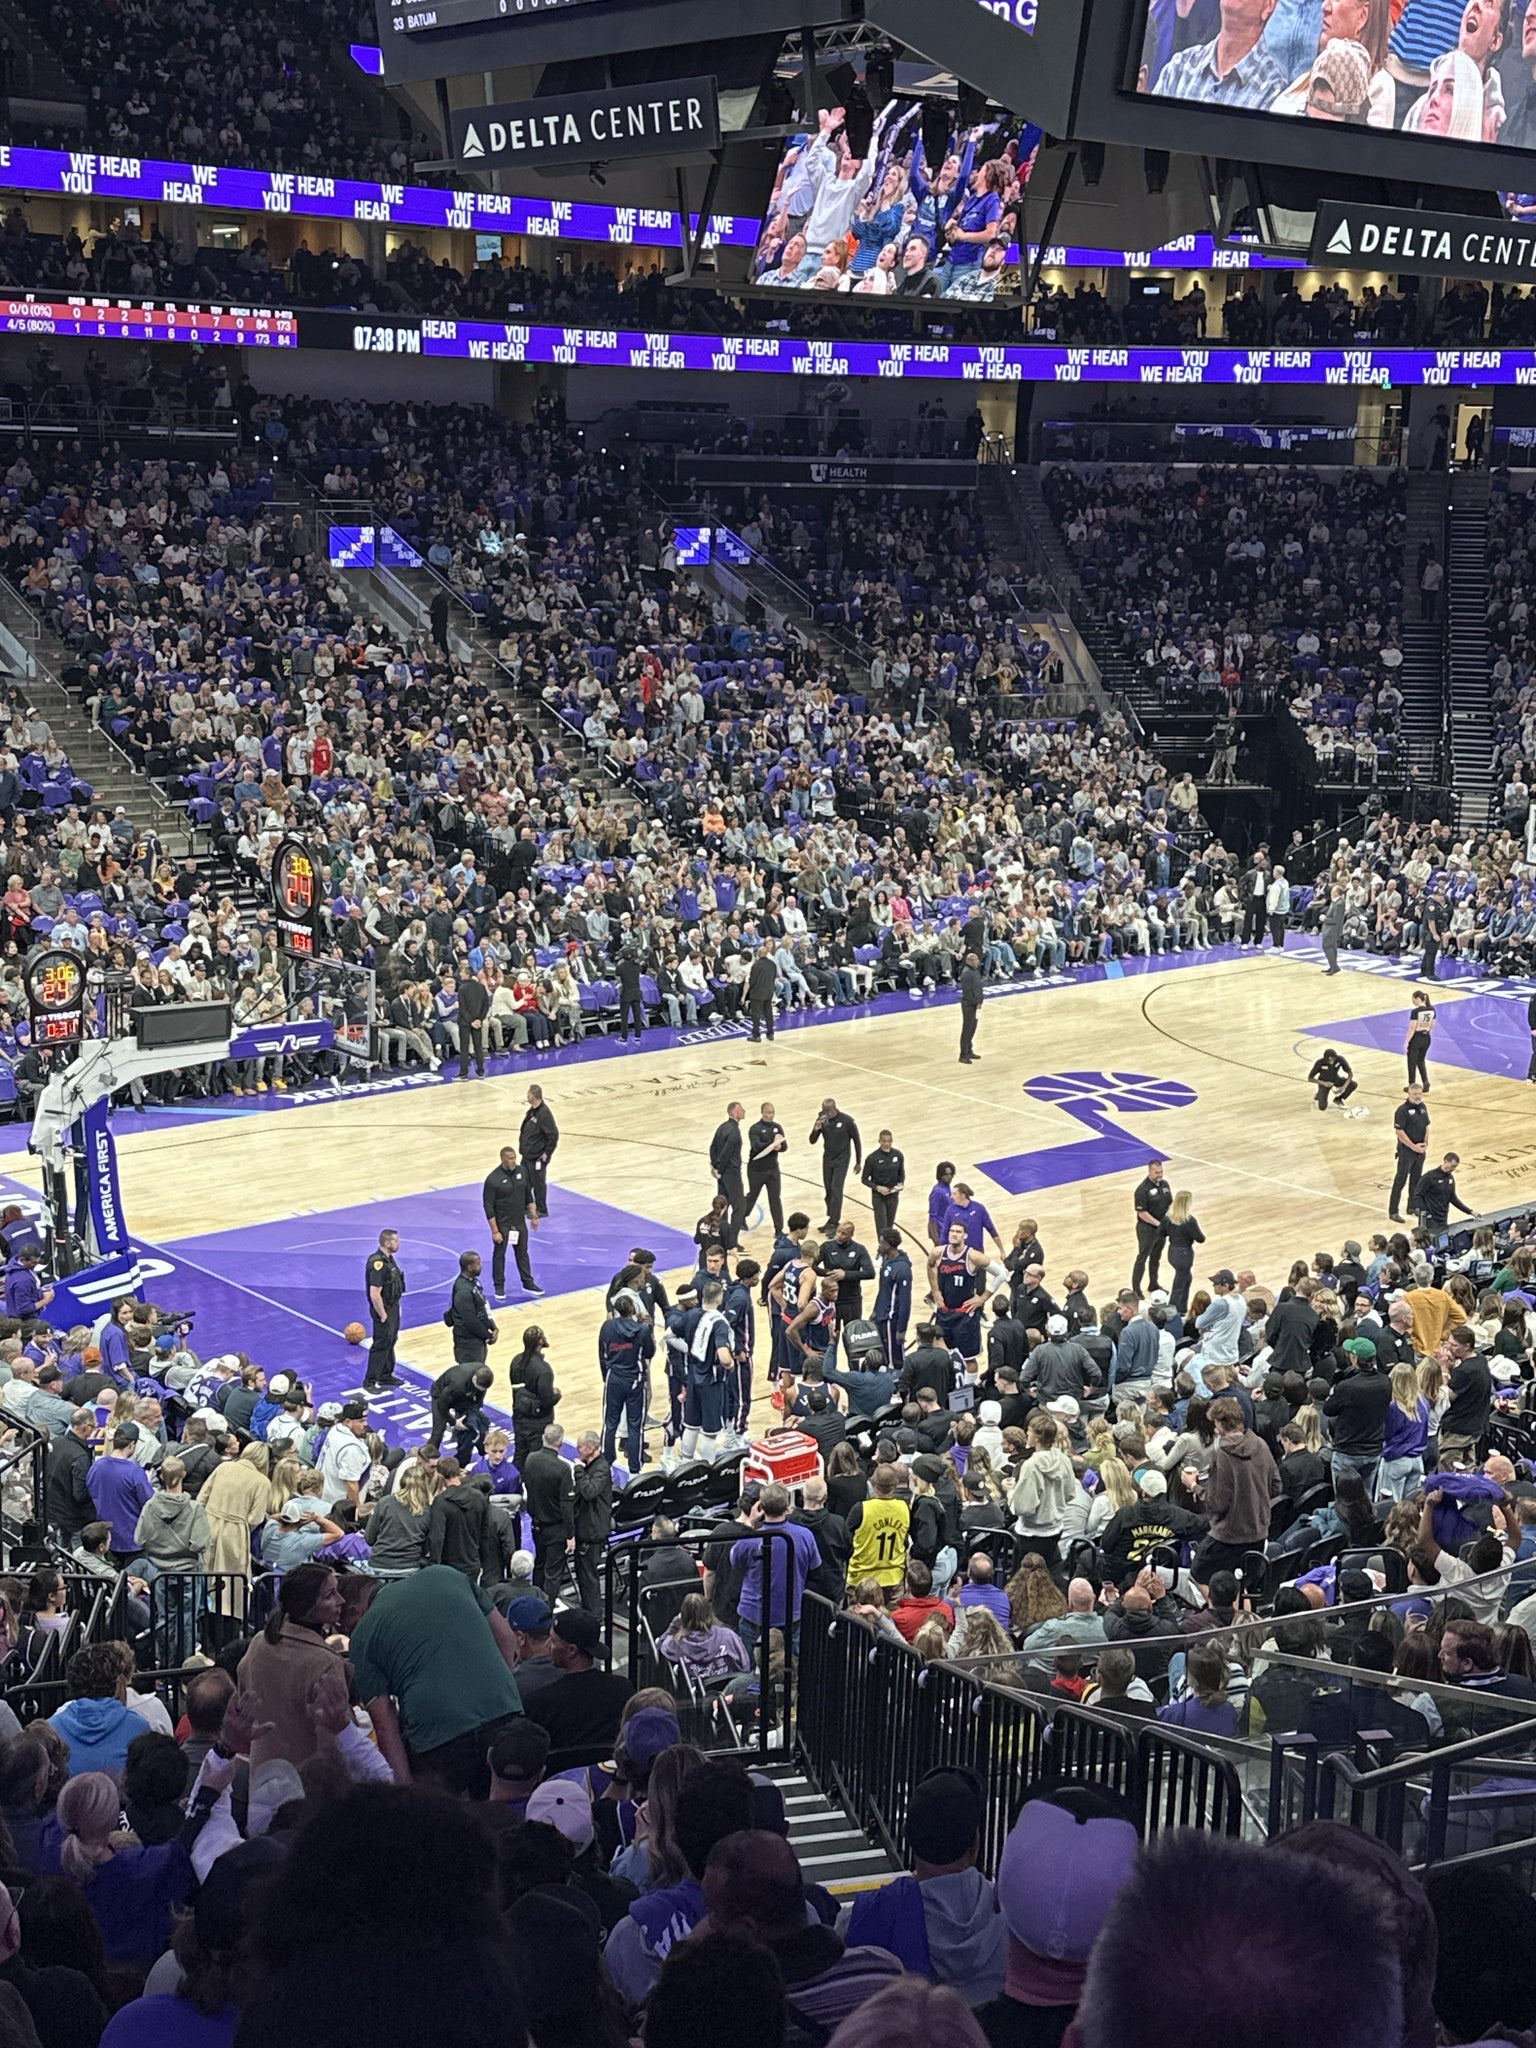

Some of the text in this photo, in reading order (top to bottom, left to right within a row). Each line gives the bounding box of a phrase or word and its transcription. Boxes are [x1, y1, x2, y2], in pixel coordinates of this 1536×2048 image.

[394, 18, 404, 31] 33
[408, 12, 437, 28] BATUM
[489, 98, 703, 151] DELTA CENTER
[70, 153, 141, 178] WE HEAR
[61, 172, 93, 194] YOU
[193, 165, 218, 186] WE
[163, 181, 203, 204] HEAR
[271, 173, 335, 197] WE HEAR
[381, 184, 404, 204] WE
[262, 191, 291, 212] YOU
[354, 200, 390, 221] HEAR
[453, 191, 511, 214] WE HEAR
[445, 208, 471, 228] YOU
[551, 202, 572, 220] WE
[616, 207, 671, 228] WE HEAR
[527, 217, 559, 237] HEAR
[713, 215, 733, 233] WE
[608, 224, 633, 243] YOU
[1360, 224, 1451, 260] DELTA
[1213, 252, 1249, 267] HEAR
[73, 308, 81, 318] 0
[98, 309, 104, 320] 2
[121, 311, 129, 321] 2
[144, 312, 152, 323] 3
[167, 314, 175, 324] 0
[191, 315, 197, 326] 1
[213, 317, 219, 327] 7
[236, 318, 244, 329] 0
[276, 321, 291, 332] 173
[422, 319, 457, 339] HEAR
[75, 322, 80, 333] 1
[98, 324, 105, 335] 5
[121, 325, 129, 336] 6
[144, 327, 153, 338] 11
[168, 328, 175, 339] 6
[190, 329, 198, 340] 0
[213, 331, 220, 341] 2
[237, 332, 244, 343] 9
[255, 334, 270, 345] 173
[354, 326, 420, 353] 07:38 PM
[504, 325, 530, 343] YOU
[563, 329, 617, 348] WE HEAR
[644, 334, 669, 351] YOU
[469, 340, 525, 361] WE HEAR
[552, 346, 577, 363] YOU
[722, 338, 779, 356] WE HEAR
[807, 341, 833, 358] YOU
[890, 344, 949, 362] WE HEAR
[978, 347, 1004, 363] YOU
[630, 350, 685, 369] WE HEAR
[711, 354, 736, 371] YOU
[792, 357, 848, 375] WE HEAR
[1067, 349, 1128, 366] WE HEAR
[1182, 351, 1209, 367] YOU
[1248, 352, 1311, 367] WE HEAR
[1343, 352, 1371, 367] YOU
[1436, 352, 1501, 368] WE HEAR
[878, 360, 903, 376] YOU
[962, 362, 1021, 379] WE HEAR
[1055, 365, 1081, 380] YOU
[1140, 366, 1202, 382] WE HEAR
[1235, 366, 1262, 382] YOU
[1325, 368, 1389, 384] WE HEAR
[1423, 368, 1450, 384] YOU
[830, 468, 867, 477] HEALTH
[286, 874, 311, 907] 24
[46, 965, 74, 983] 3:06
[43, 981, 68, 1002] 24
[48, 1010, 81, 1020] TISSOT
[641, 1064, 744, 1085] DELTA
[96, 1130, 119, 1241] AMERICA FIRST
[954, 1275, 964, 1287] 11
[876, 1532, 897, 1561] 11
